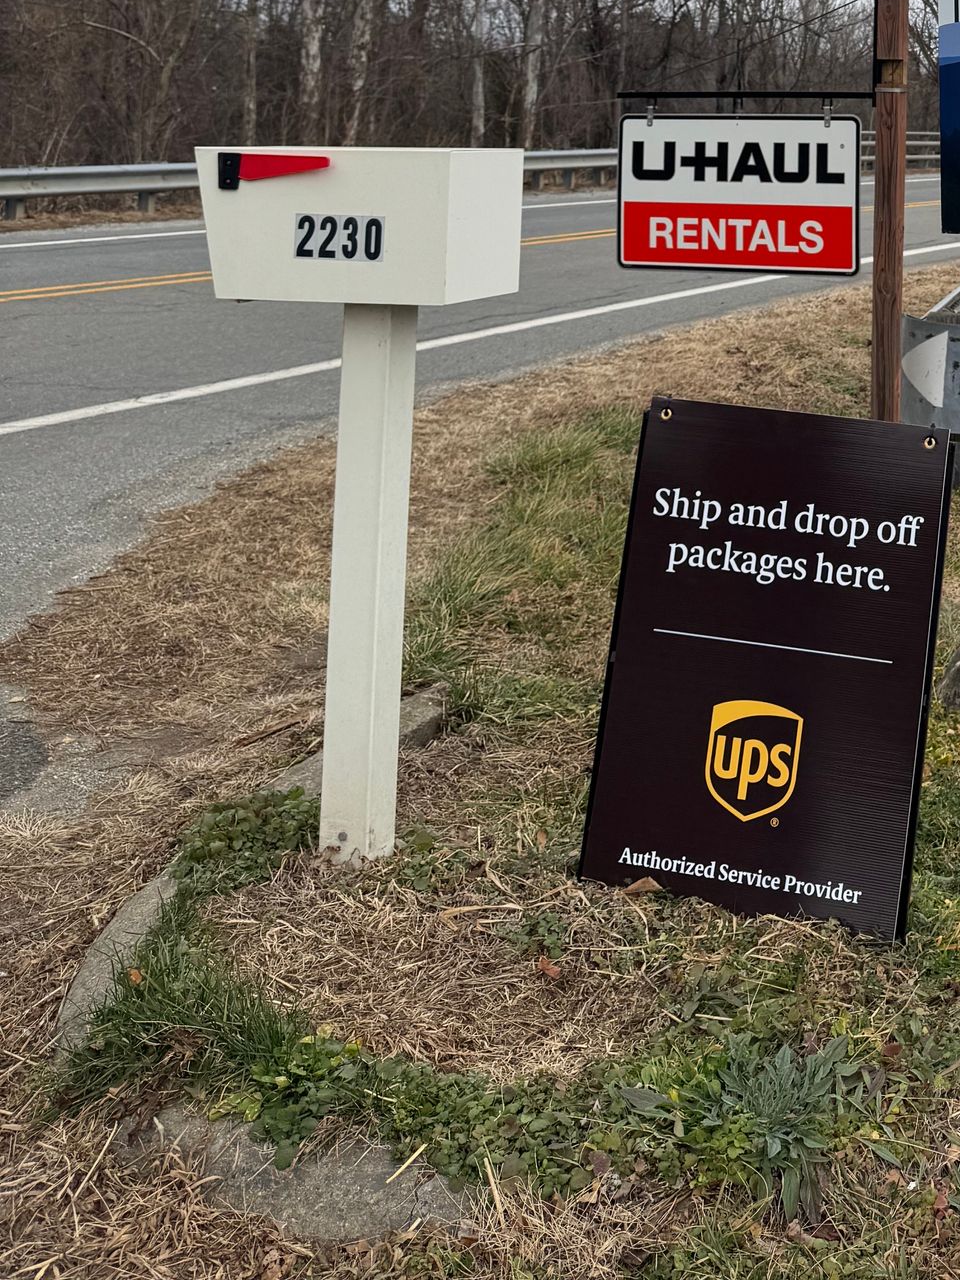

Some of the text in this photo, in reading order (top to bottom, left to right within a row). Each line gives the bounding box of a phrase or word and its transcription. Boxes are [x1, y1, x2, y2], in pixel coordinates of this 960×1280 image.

[631, 140, 845, 185] U-HAUL
[295, 214, 383, 261] 2230
[649, 216, 824, 254] RENTALS
[652, 487, 925, 548] Ship and drop off
[665, 540, 891, 592] packages here.
[713, 734, 792, 801] ups
[618, 847, 863, 905] Authorized Service Provider
